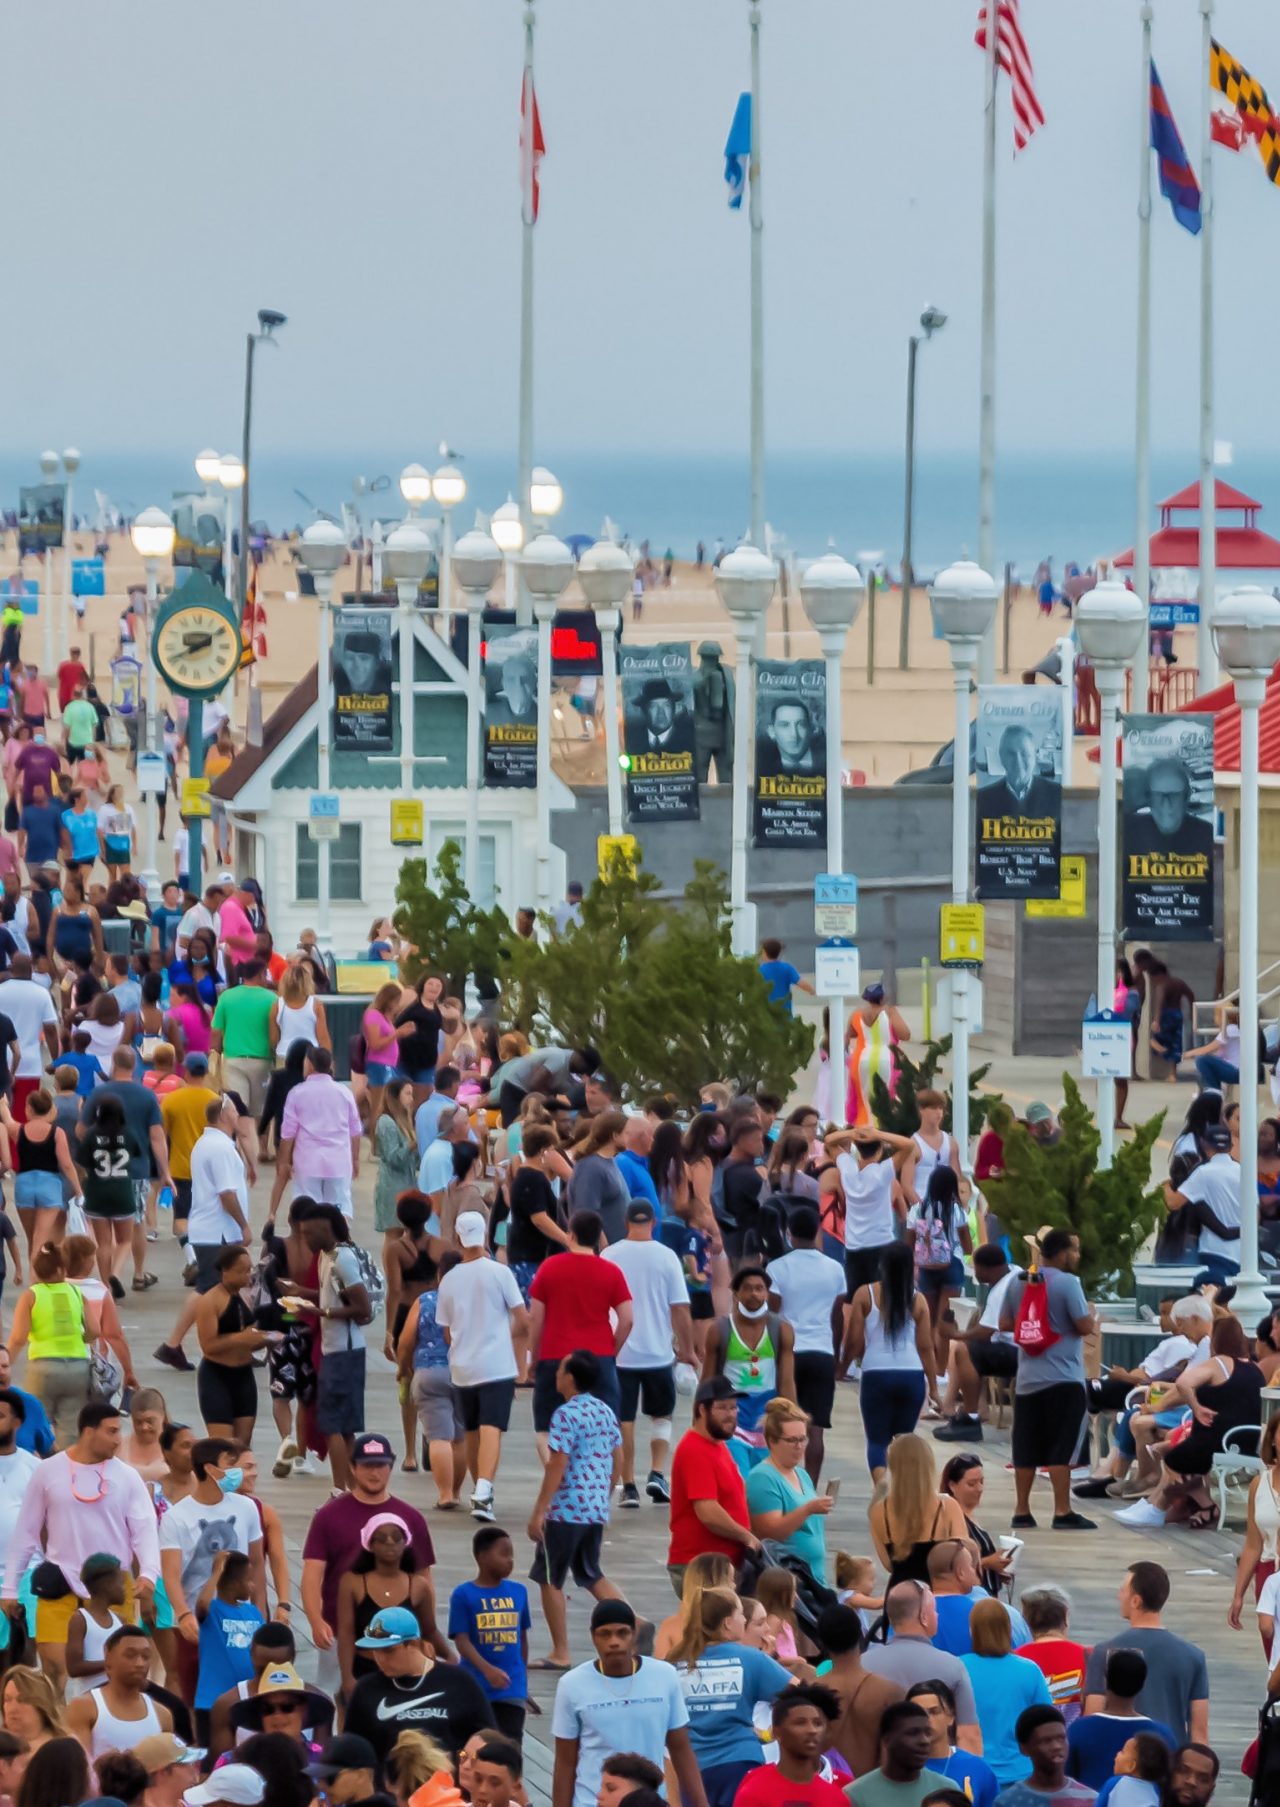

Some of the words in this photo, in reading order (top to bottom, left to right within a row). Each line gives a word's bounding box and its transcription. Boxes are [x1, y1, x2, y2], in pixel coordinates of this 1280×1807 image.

[623, 656, 659, 669] Ocean
[662, 654, 687, 671] City
[759, 671, 797, 685] Ocean
[488, 725, 536, 741] Hono
[630, 755, 690, 773] Honor
[760, 776, 823, 796] Honor
[1002, 815, 1017, 825] We
[982, 818, 1052, 839] Honor
[1129, 854, 1206, 878] Honor
[1150, 851, 1167, 862] We
[1168, 851, 1209, 870] Proudly
[998, 867, 1015, 876] U.S.
[1137, 907, 1155, 916] U.S.
[1157, 907, 1172, 916] AIR
[1174, 907, 1199, 916] FORCE
[93, 1148, 130, 1177] 32
[481, 1598, 488, 1610] I
[490, 1597, 515, 1610] CAN
[479, 1631, 518, 1644] THINGS
[690, 1683, 711, 1694] VA
[713, 1681, 740, 1693] FFA
[397, 1707, 449, 1721] BASEBALL
